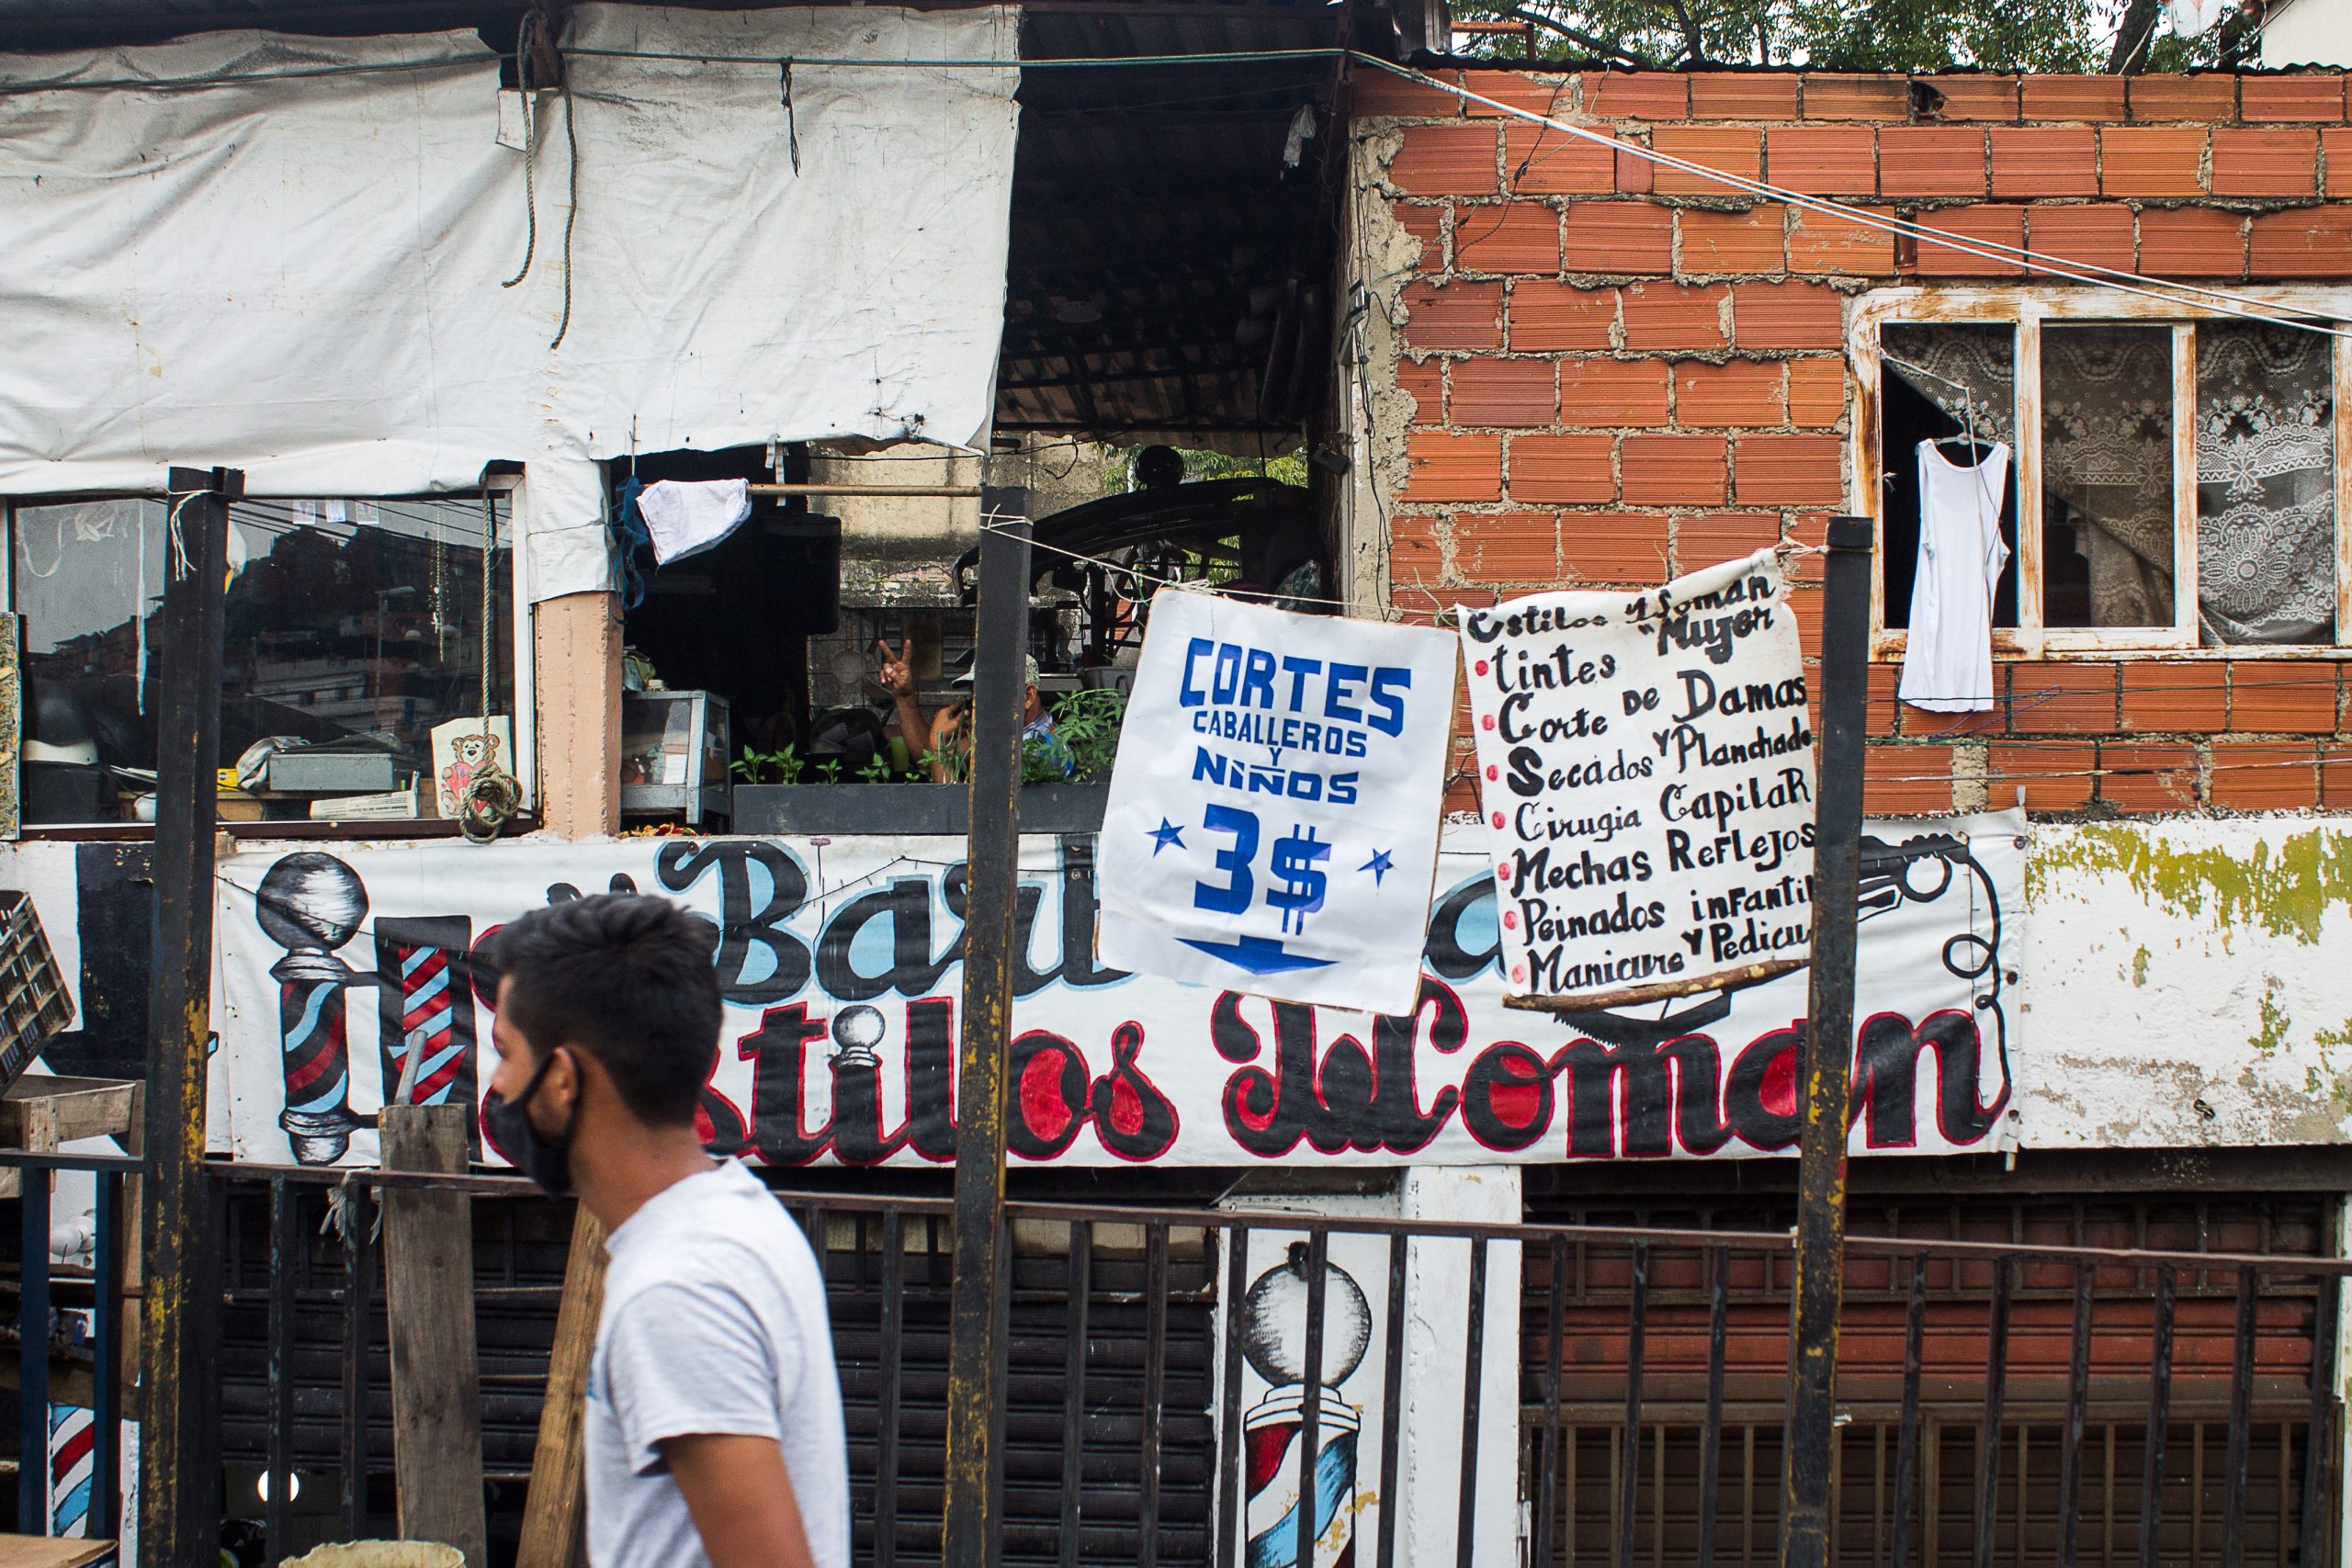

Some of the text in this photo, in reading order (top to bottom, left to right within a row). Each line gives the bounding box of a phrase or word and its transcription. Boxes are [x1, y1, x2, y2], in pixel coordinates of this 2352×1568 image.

[1180, 637, 1410, 738] CORTES
[1498, 693, 1608, 744] Corte
[1672, 670, 1807, 723] Damas
[1193, 710, 1367, 758] CABALLEROS
[1269, 747, 1283, 766] Y
[1507, 746, 1653, 796] Secados
[1515, 802, 1642, 841] Cirugia
[1194, 803, 1331, 936] 3$
[1510, 847, 1653, 898] Mechas
[1519, 891, 1665, 946] Peinados
[1527, 943, 1684, 994] Manicure
